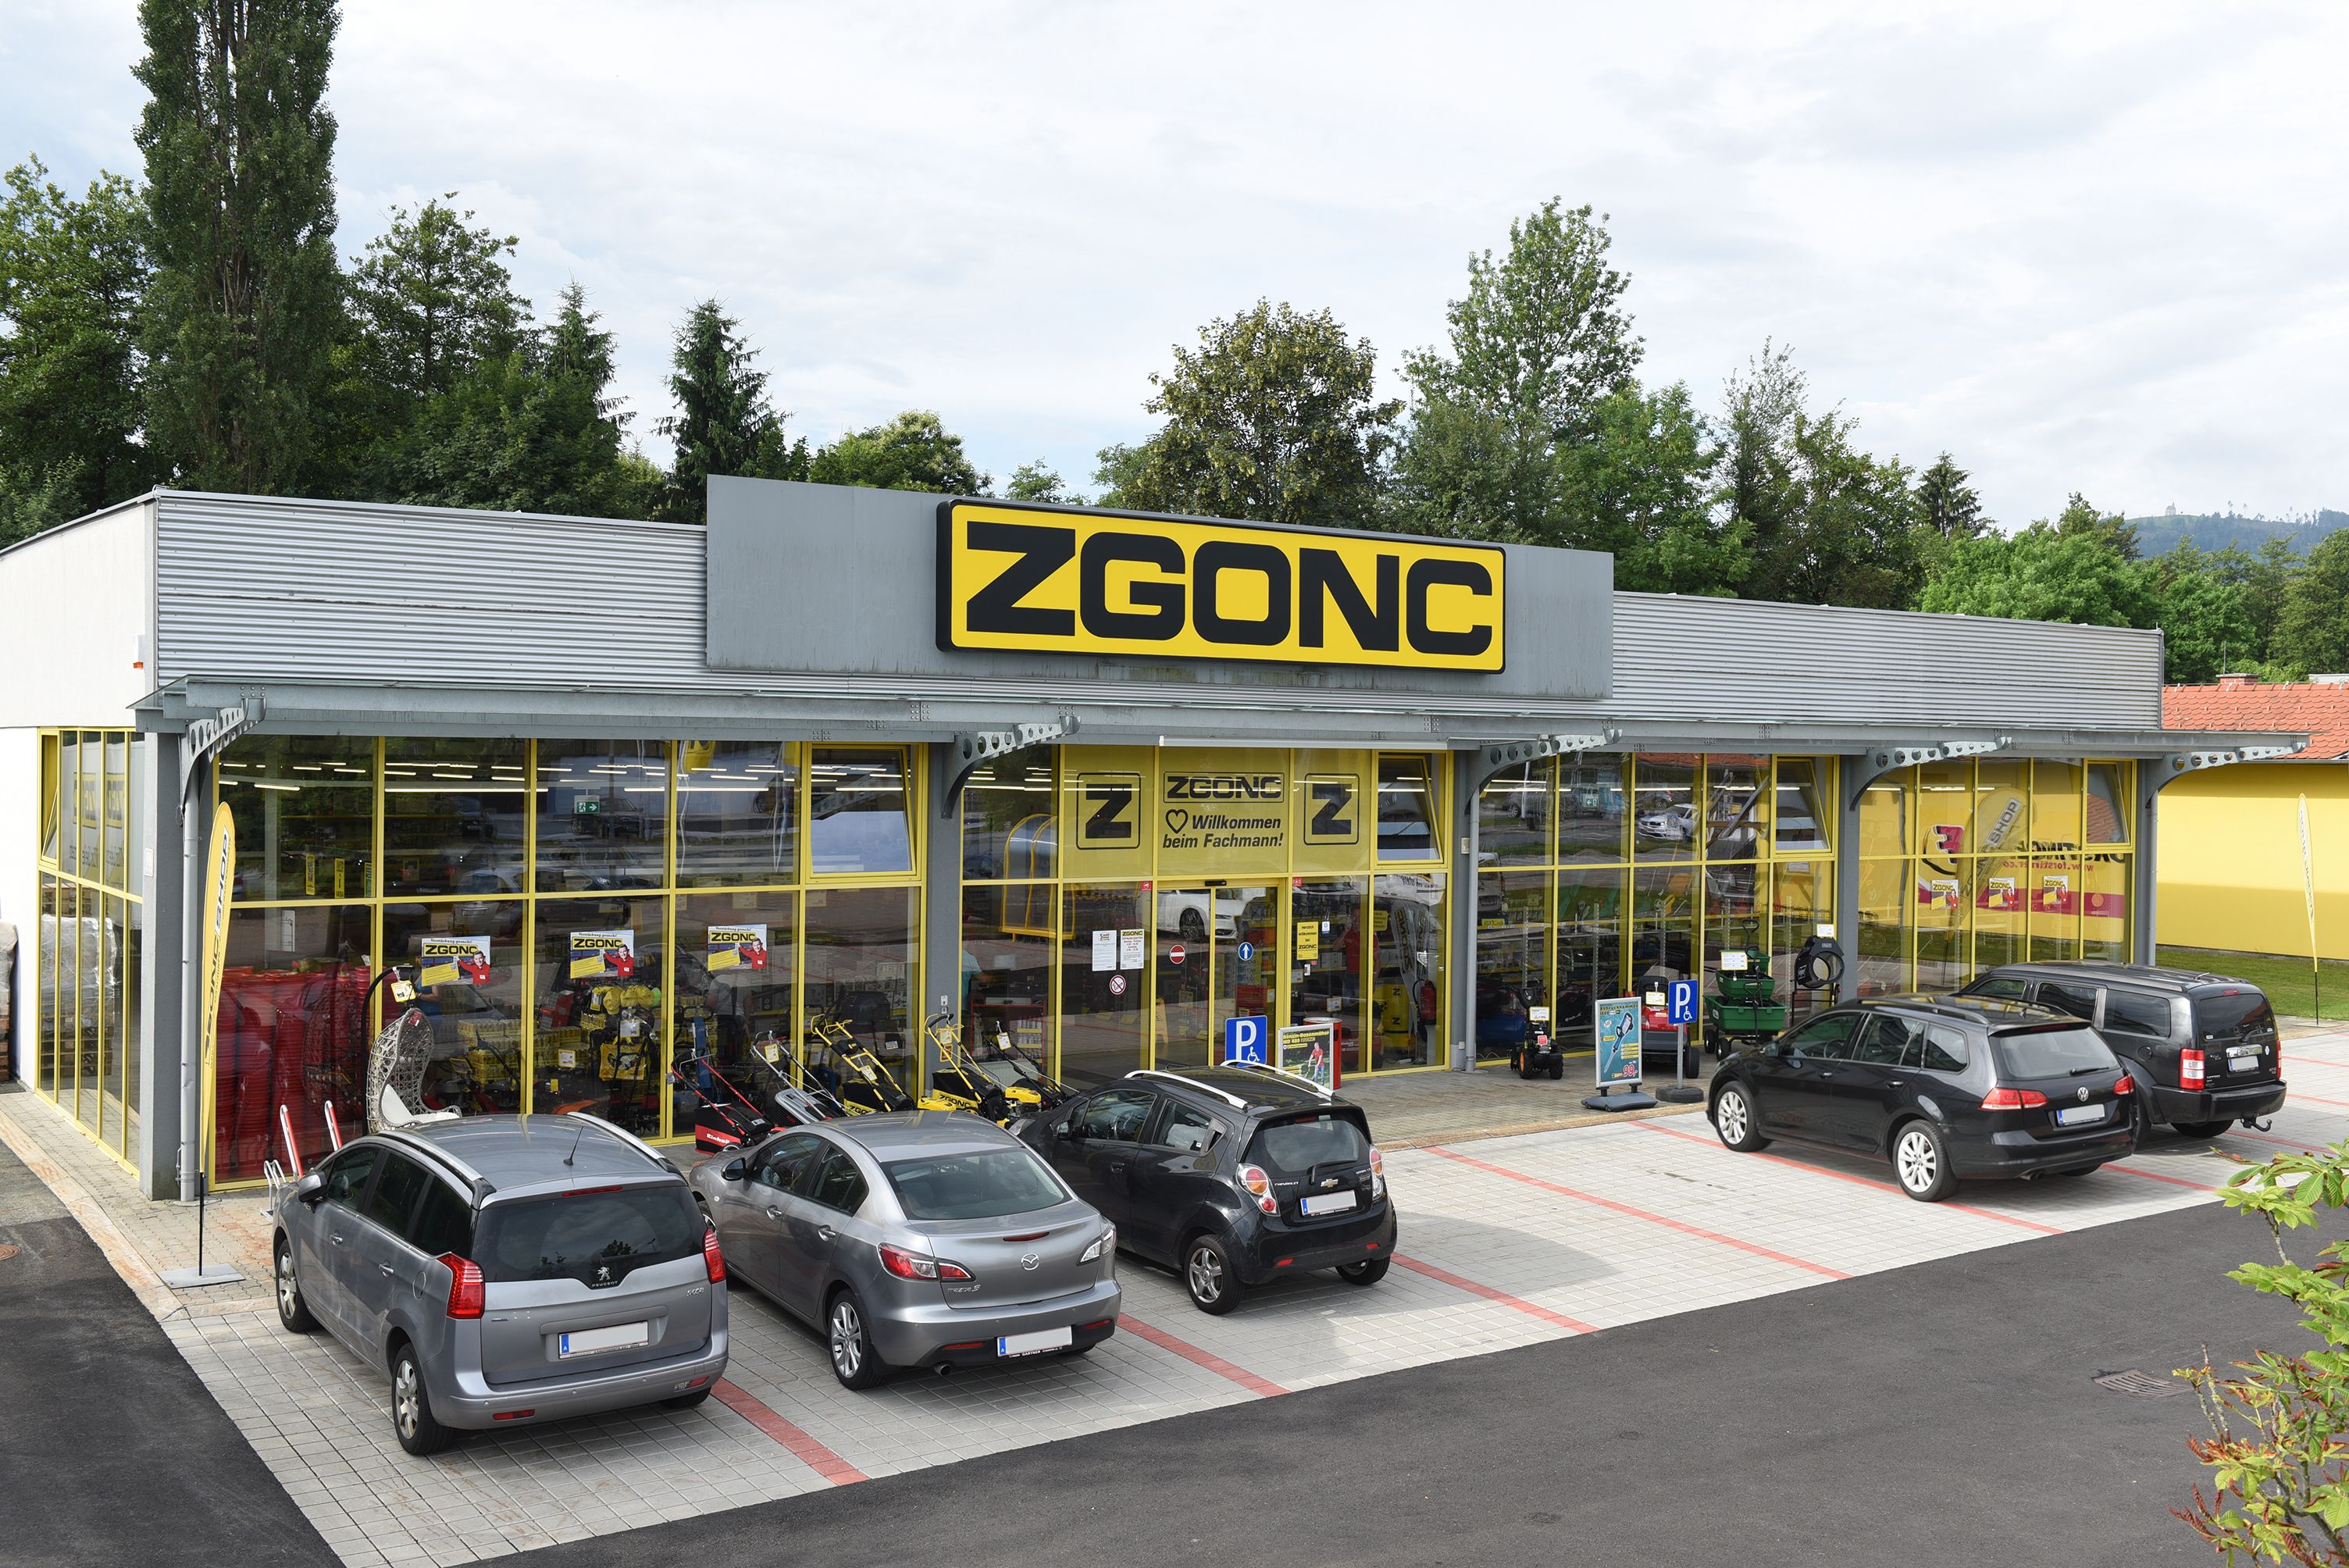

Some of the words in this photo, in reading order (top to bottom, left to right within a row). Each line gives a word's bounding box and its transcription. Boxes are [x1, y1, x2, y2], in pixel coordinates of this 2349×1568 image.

[966, 521, 1492, 656] ZGONC
[1167, 775, 1281, 799] ZGONC
[1085, 784, 1132, 839] Z
[1311, 784, 1352, 836] Z
[1192, 814, 1281, 830] Willkommen
[1992, 801, 2018, 844] SHOP
[1163, 833, 1198, 849] beim
[1203, 832, 1284, 849] Fachmann!
[216, 834, 228, 928] SHOP
[574, 939, 622, 948] ZGONC
[711, 932, 755, 942] ZGONC
[426, 945, 477, 955] ZGONC
[1675, 983, 1691, 1018] P
[1236, 1020, 1256, 1061] P
[848, 1105, 871, 1115] ZGO
[939, 1095, 971, 1109] ZGONC
[707, 1133, 730, 1144] Einhell
